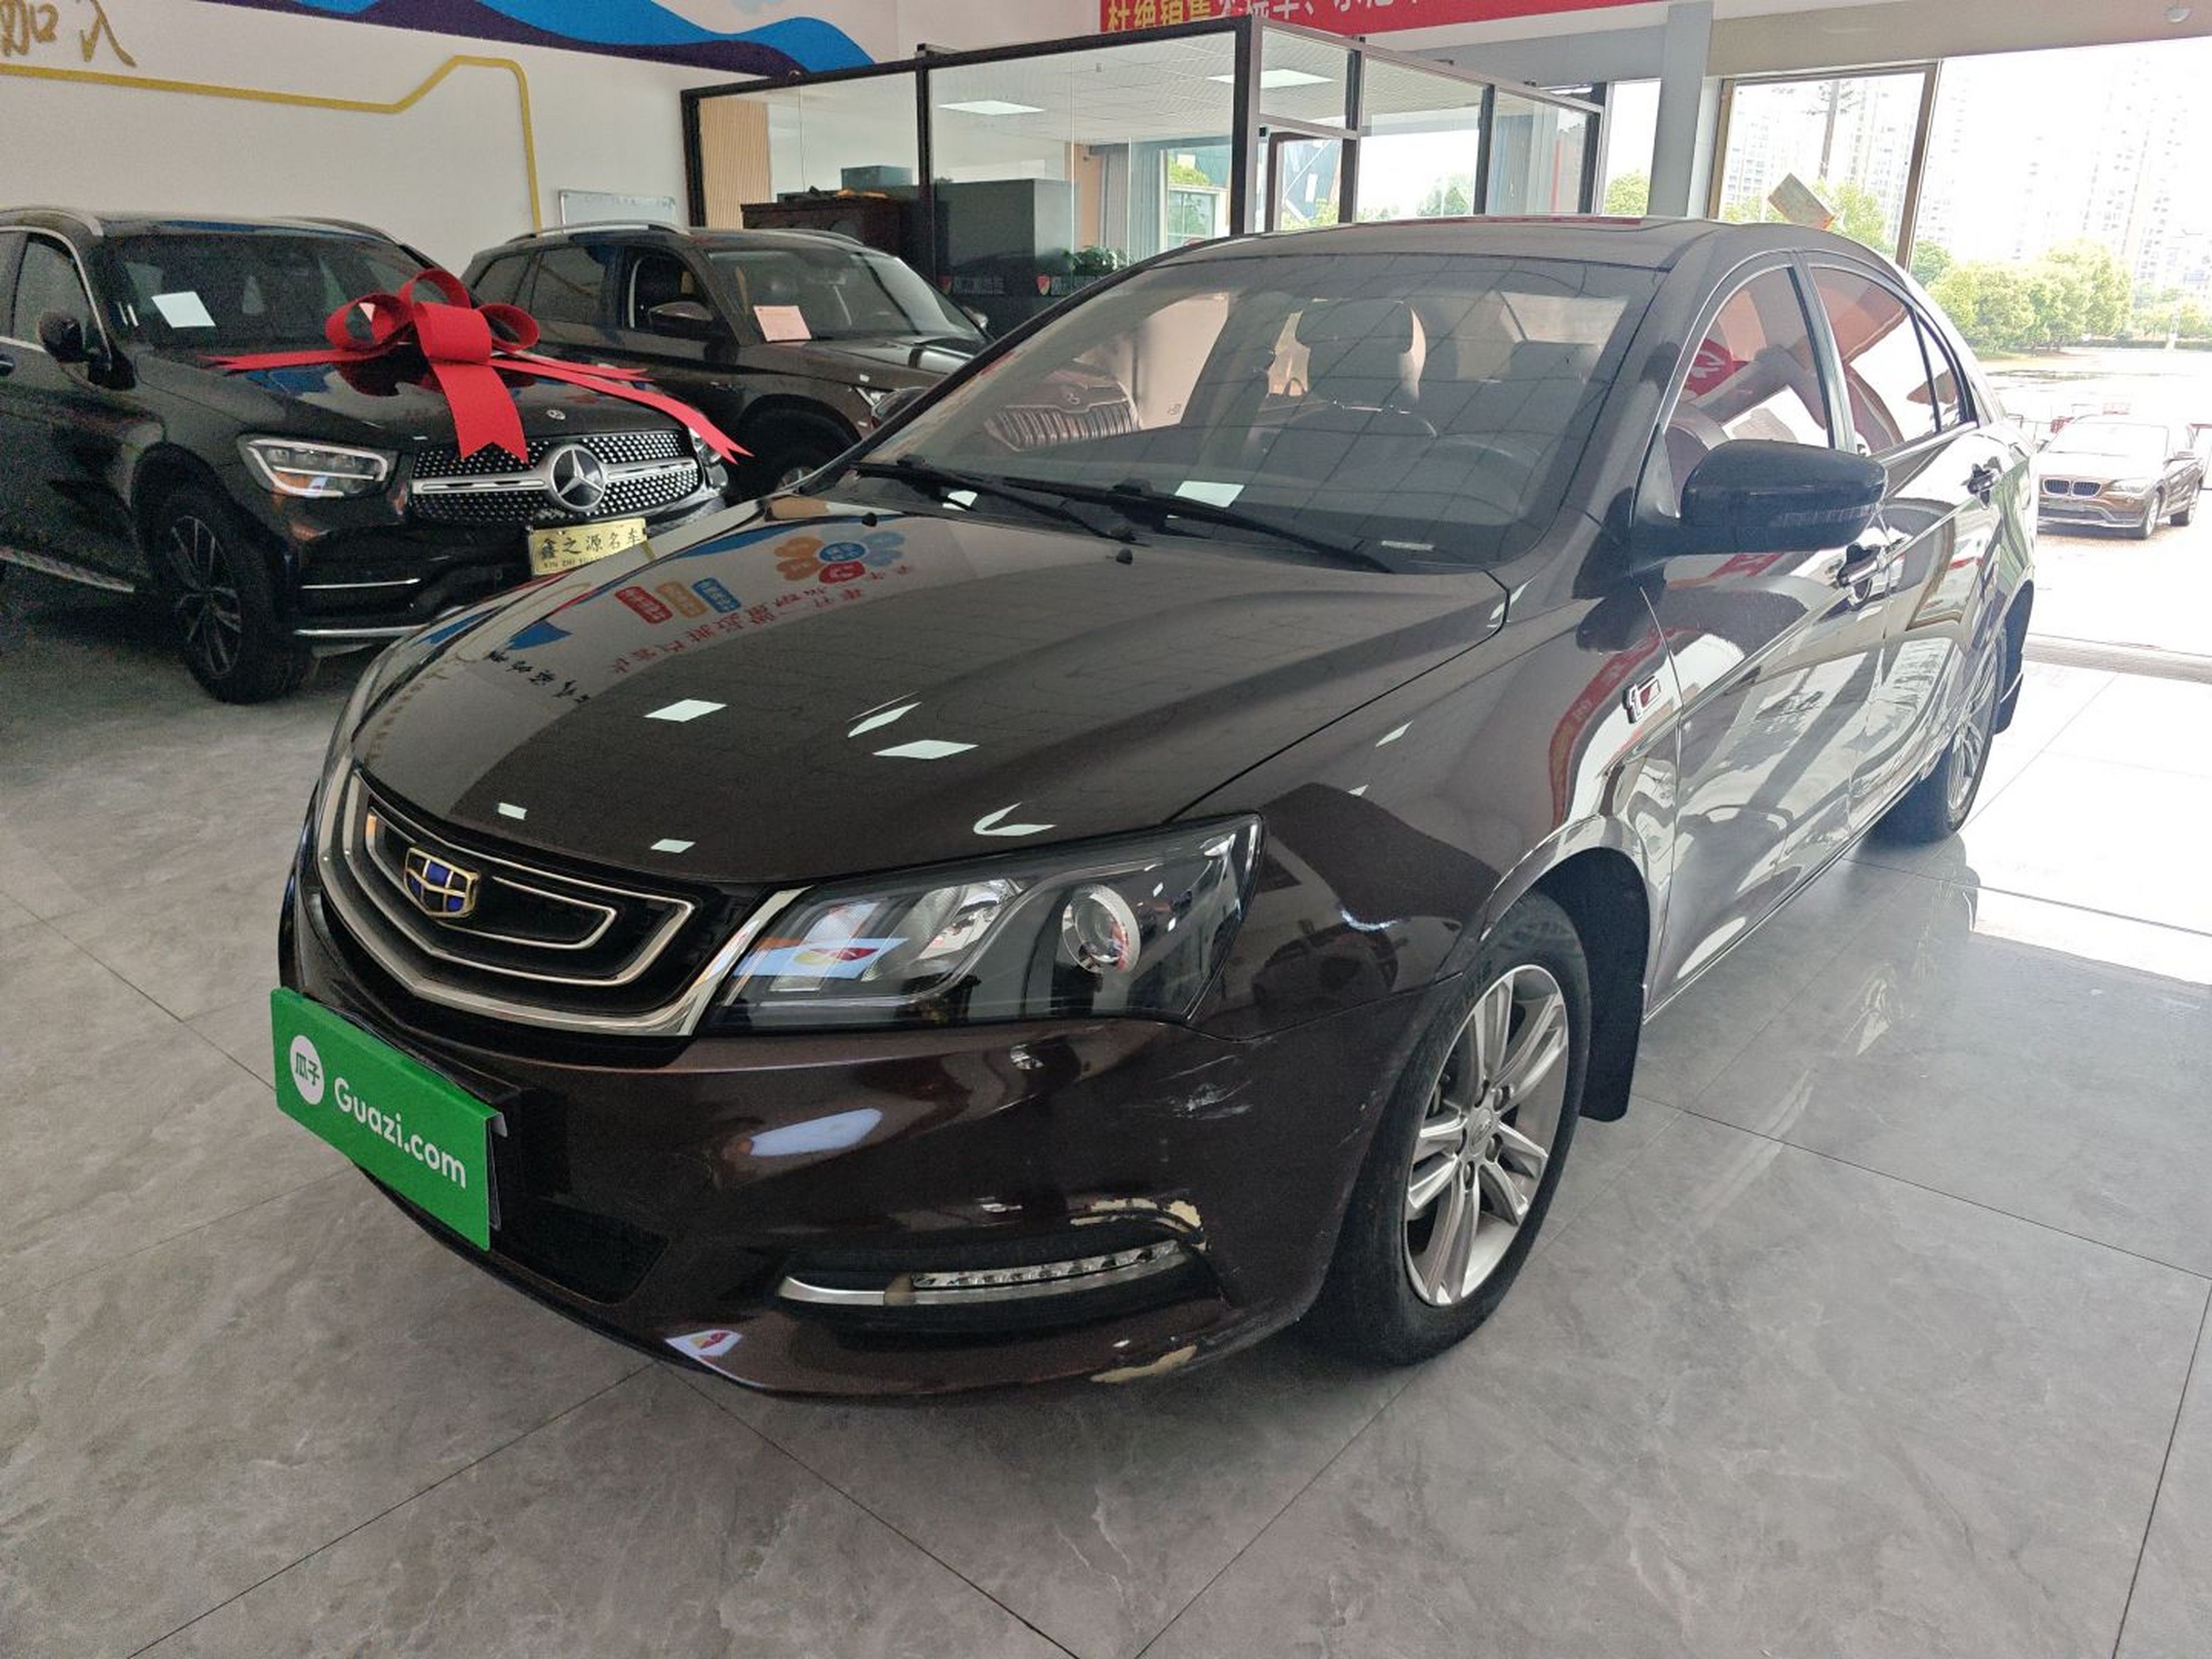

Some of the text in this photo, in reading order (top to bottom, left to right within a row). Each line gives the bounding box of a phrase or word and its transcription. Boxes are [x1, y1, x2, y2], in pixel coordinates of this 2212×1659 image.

[540, 527, 641, 559] 鑫之源名车
[294, 1051, 321, 1086] 瓜子
[334, 1077, 467, 1189] Guazi.com
